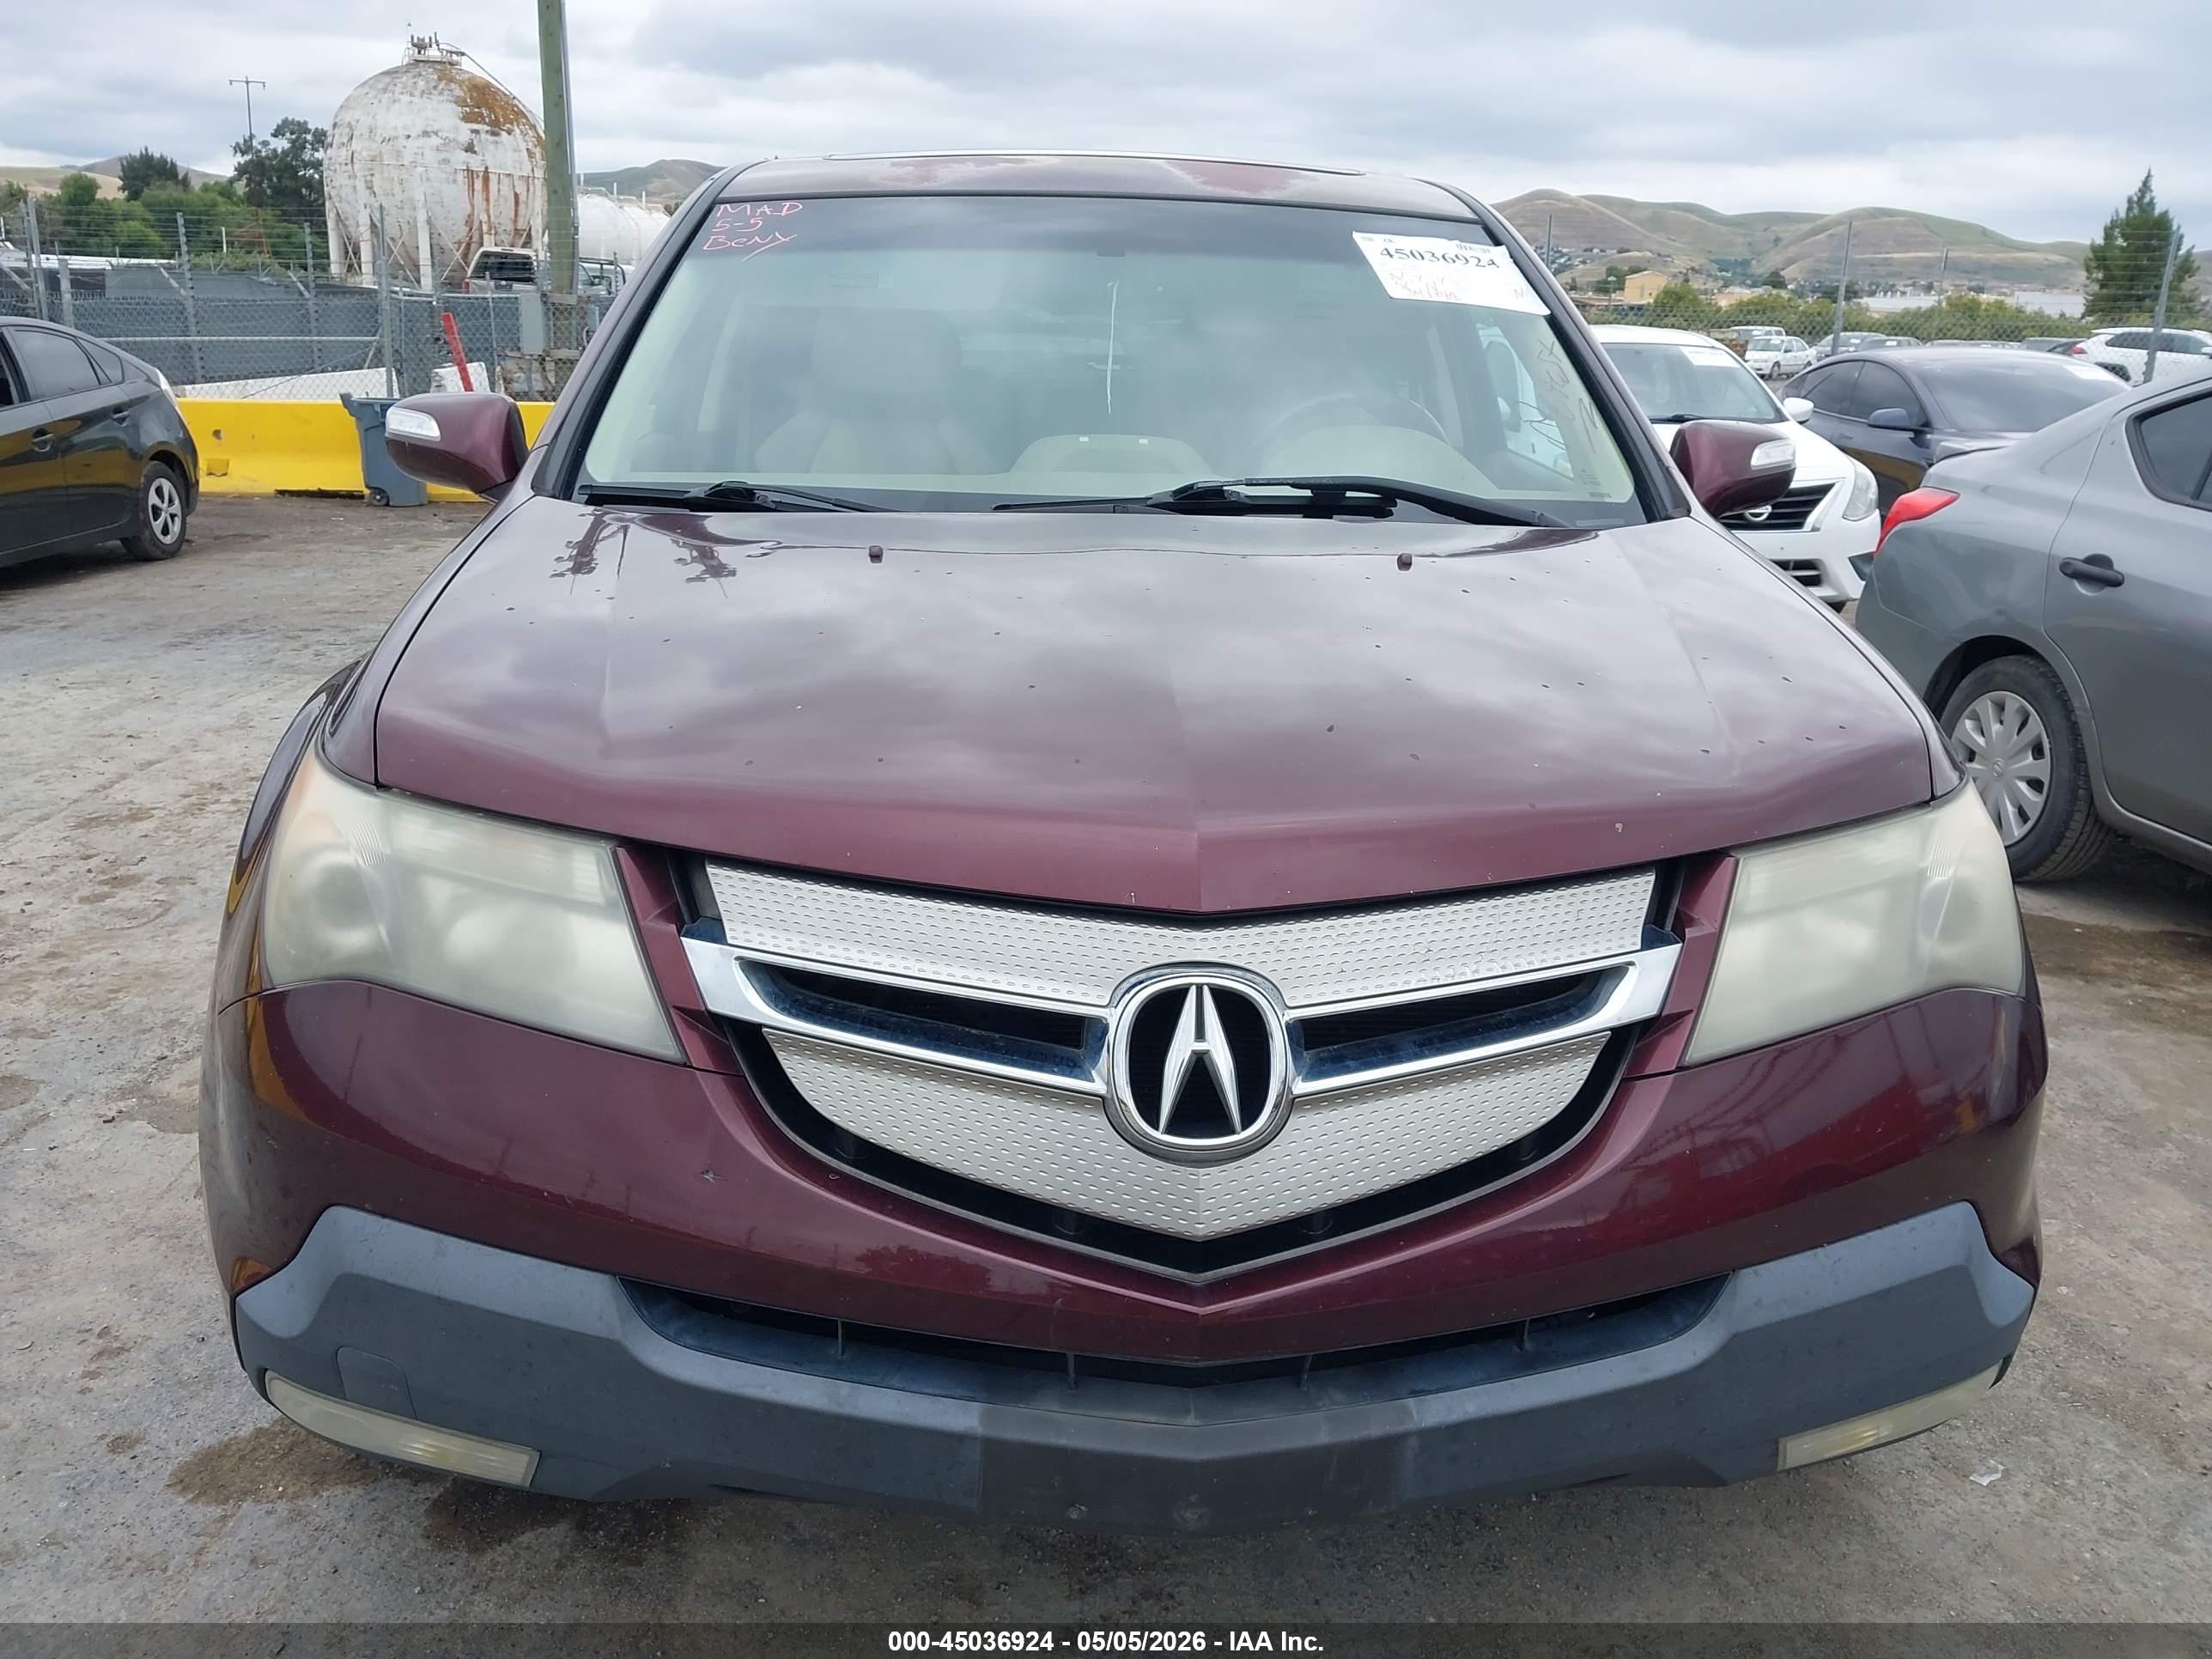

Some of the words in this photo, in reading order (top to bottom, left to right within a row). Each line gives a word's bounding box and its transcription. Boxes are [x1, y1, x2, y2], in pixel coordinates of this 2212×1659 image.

[716, 202, 803, 216] MAD
[711, 217, 763, 232] 5-5
[1380, 246, 1500, 269] 45036924
